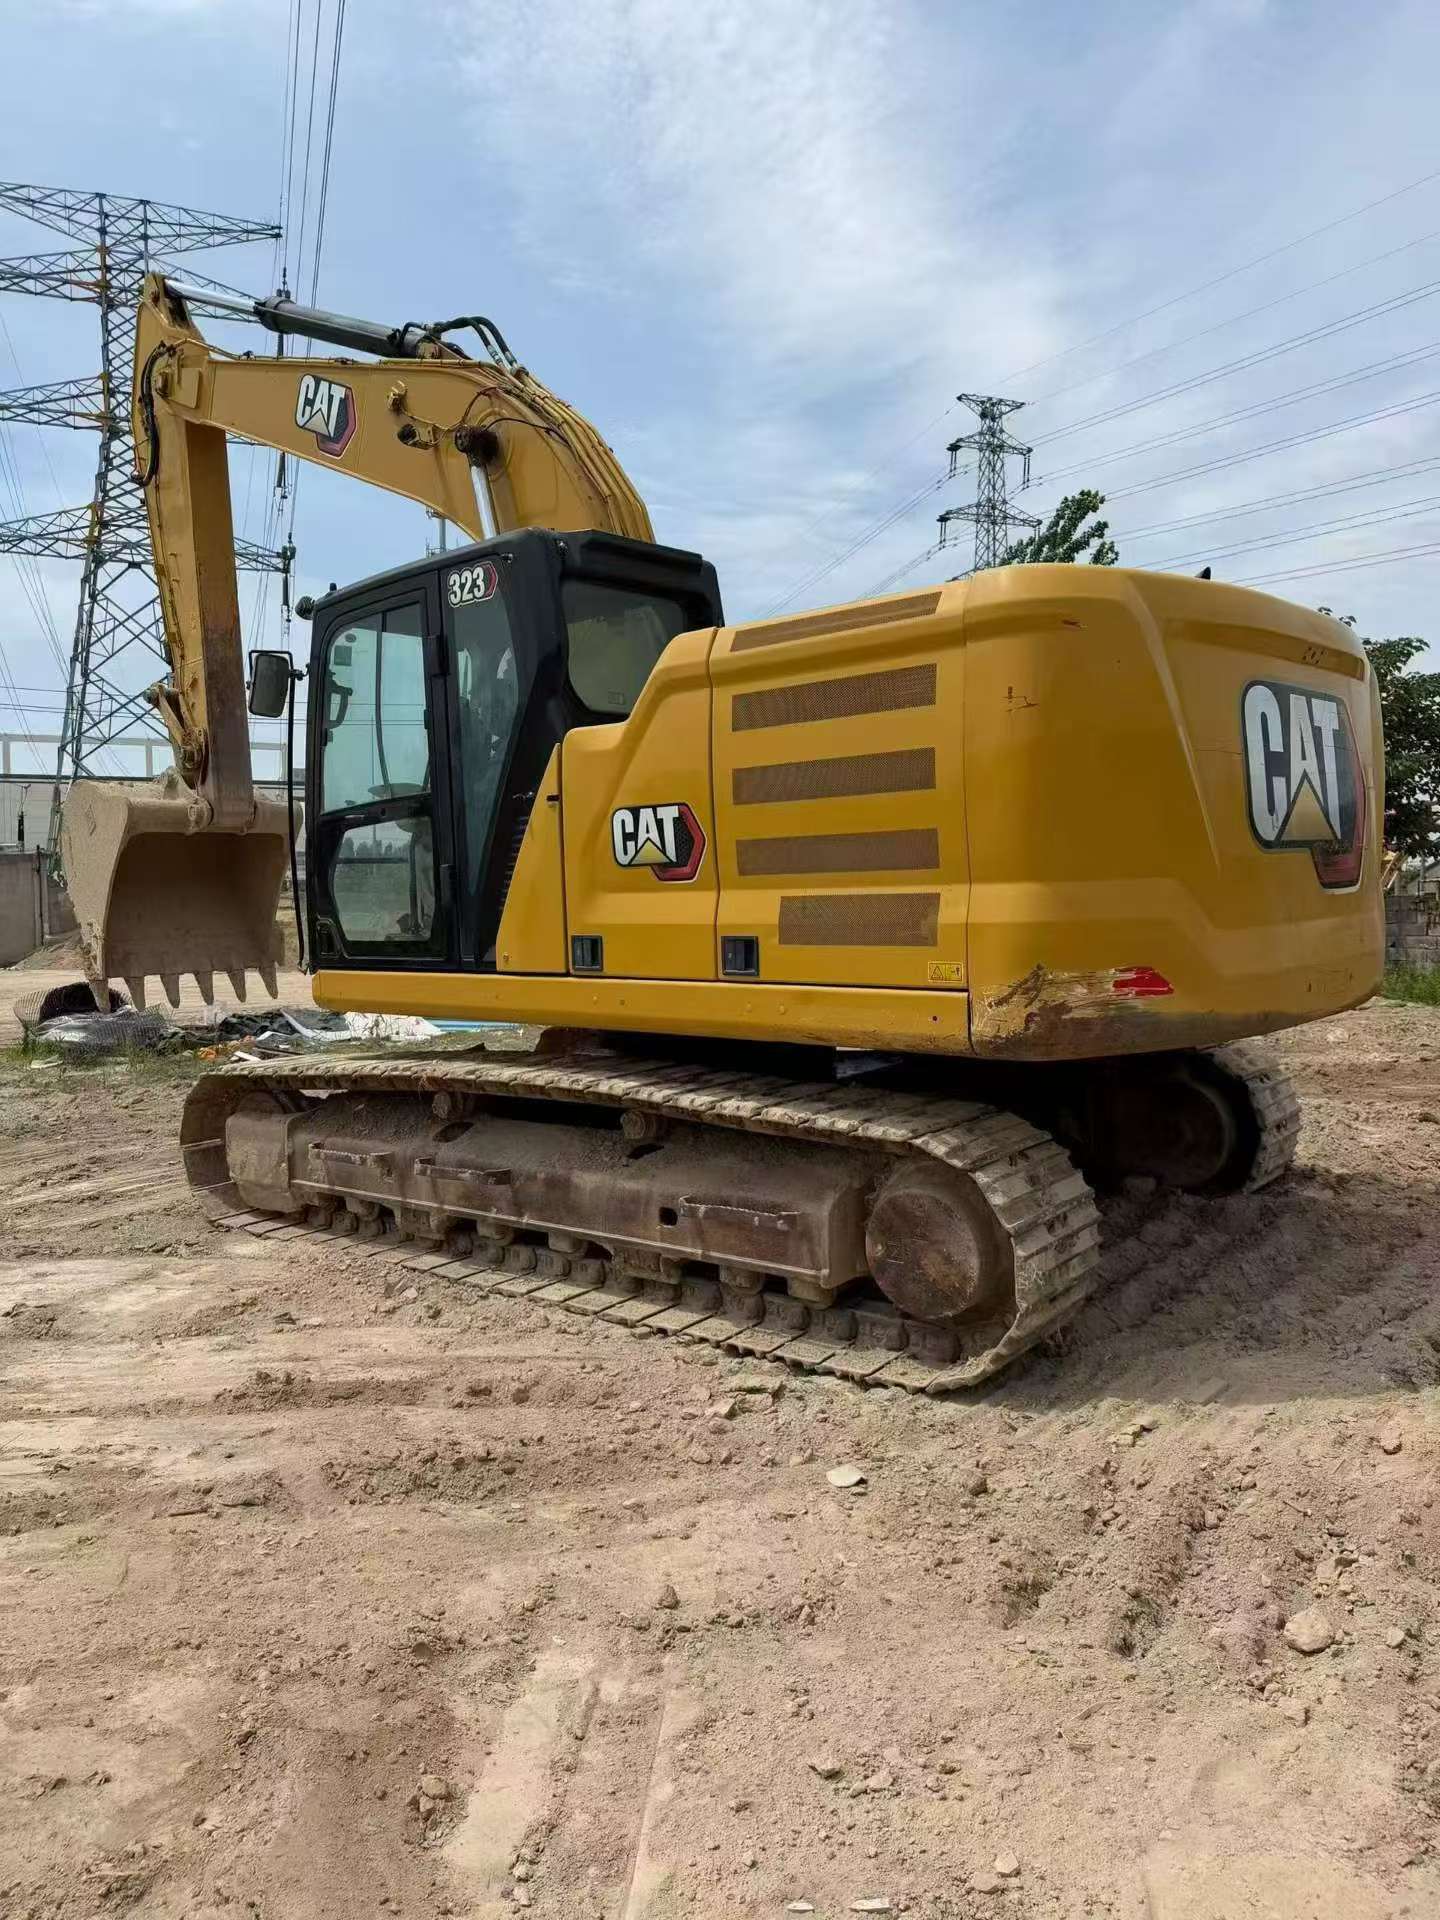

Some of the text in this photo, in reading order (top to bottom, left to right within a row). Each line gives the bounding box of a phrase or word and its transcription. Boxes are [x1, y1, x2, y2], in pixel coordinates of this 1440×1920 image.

[296, 375, 346, 438] CAT
[449, 566, 485, 605] 323
[1244, 685, 1341, 841] CAT
[613, 805, 679, 865] CAT
